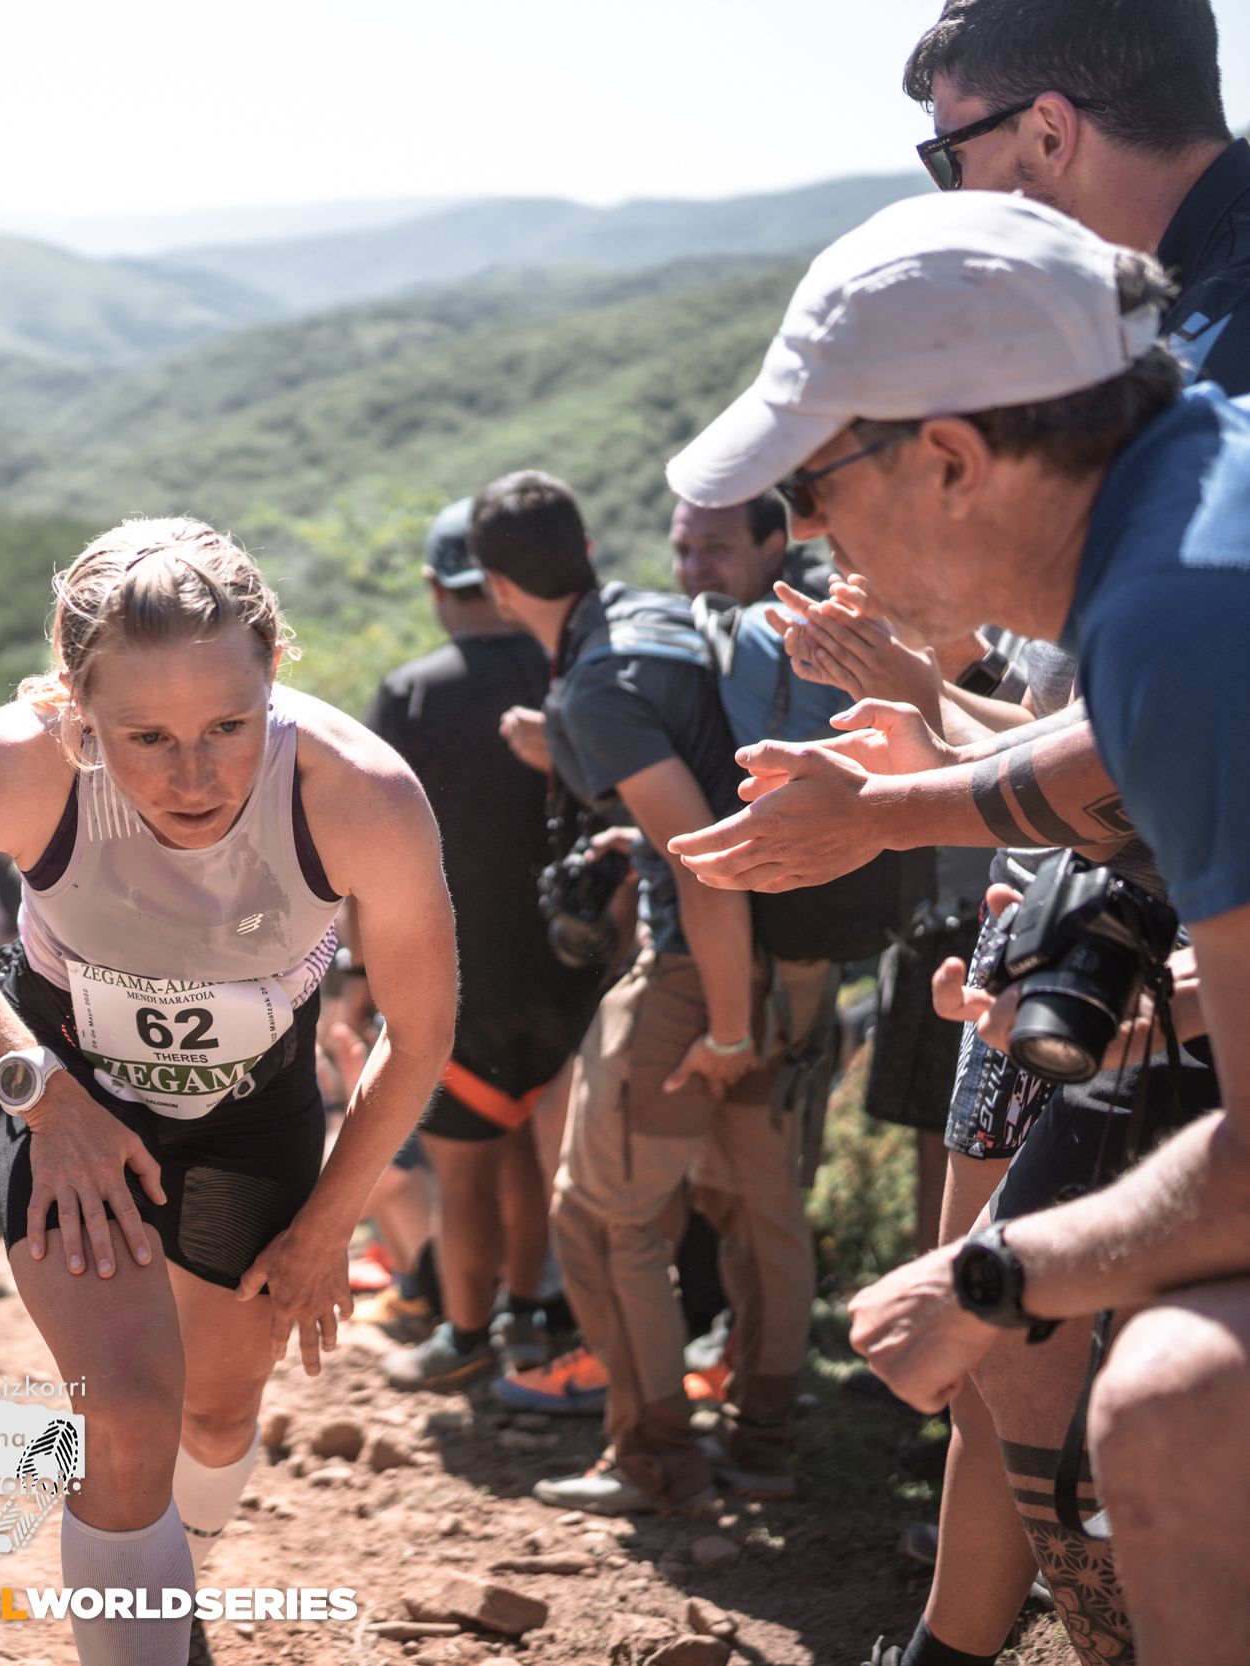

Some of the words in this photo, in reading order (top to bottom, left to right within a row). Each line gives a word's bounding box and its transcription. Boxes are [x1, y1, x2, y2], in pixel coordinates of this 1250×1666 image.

[126, 991, 157, 1005] MENDI
[158, 991, 216, 1006] MARATOIA
[135, 1007, 220, 1050] 62
[153, 1052, 209, 1064] THERES
[103, 1055, 263, 1094] ZEGAM
